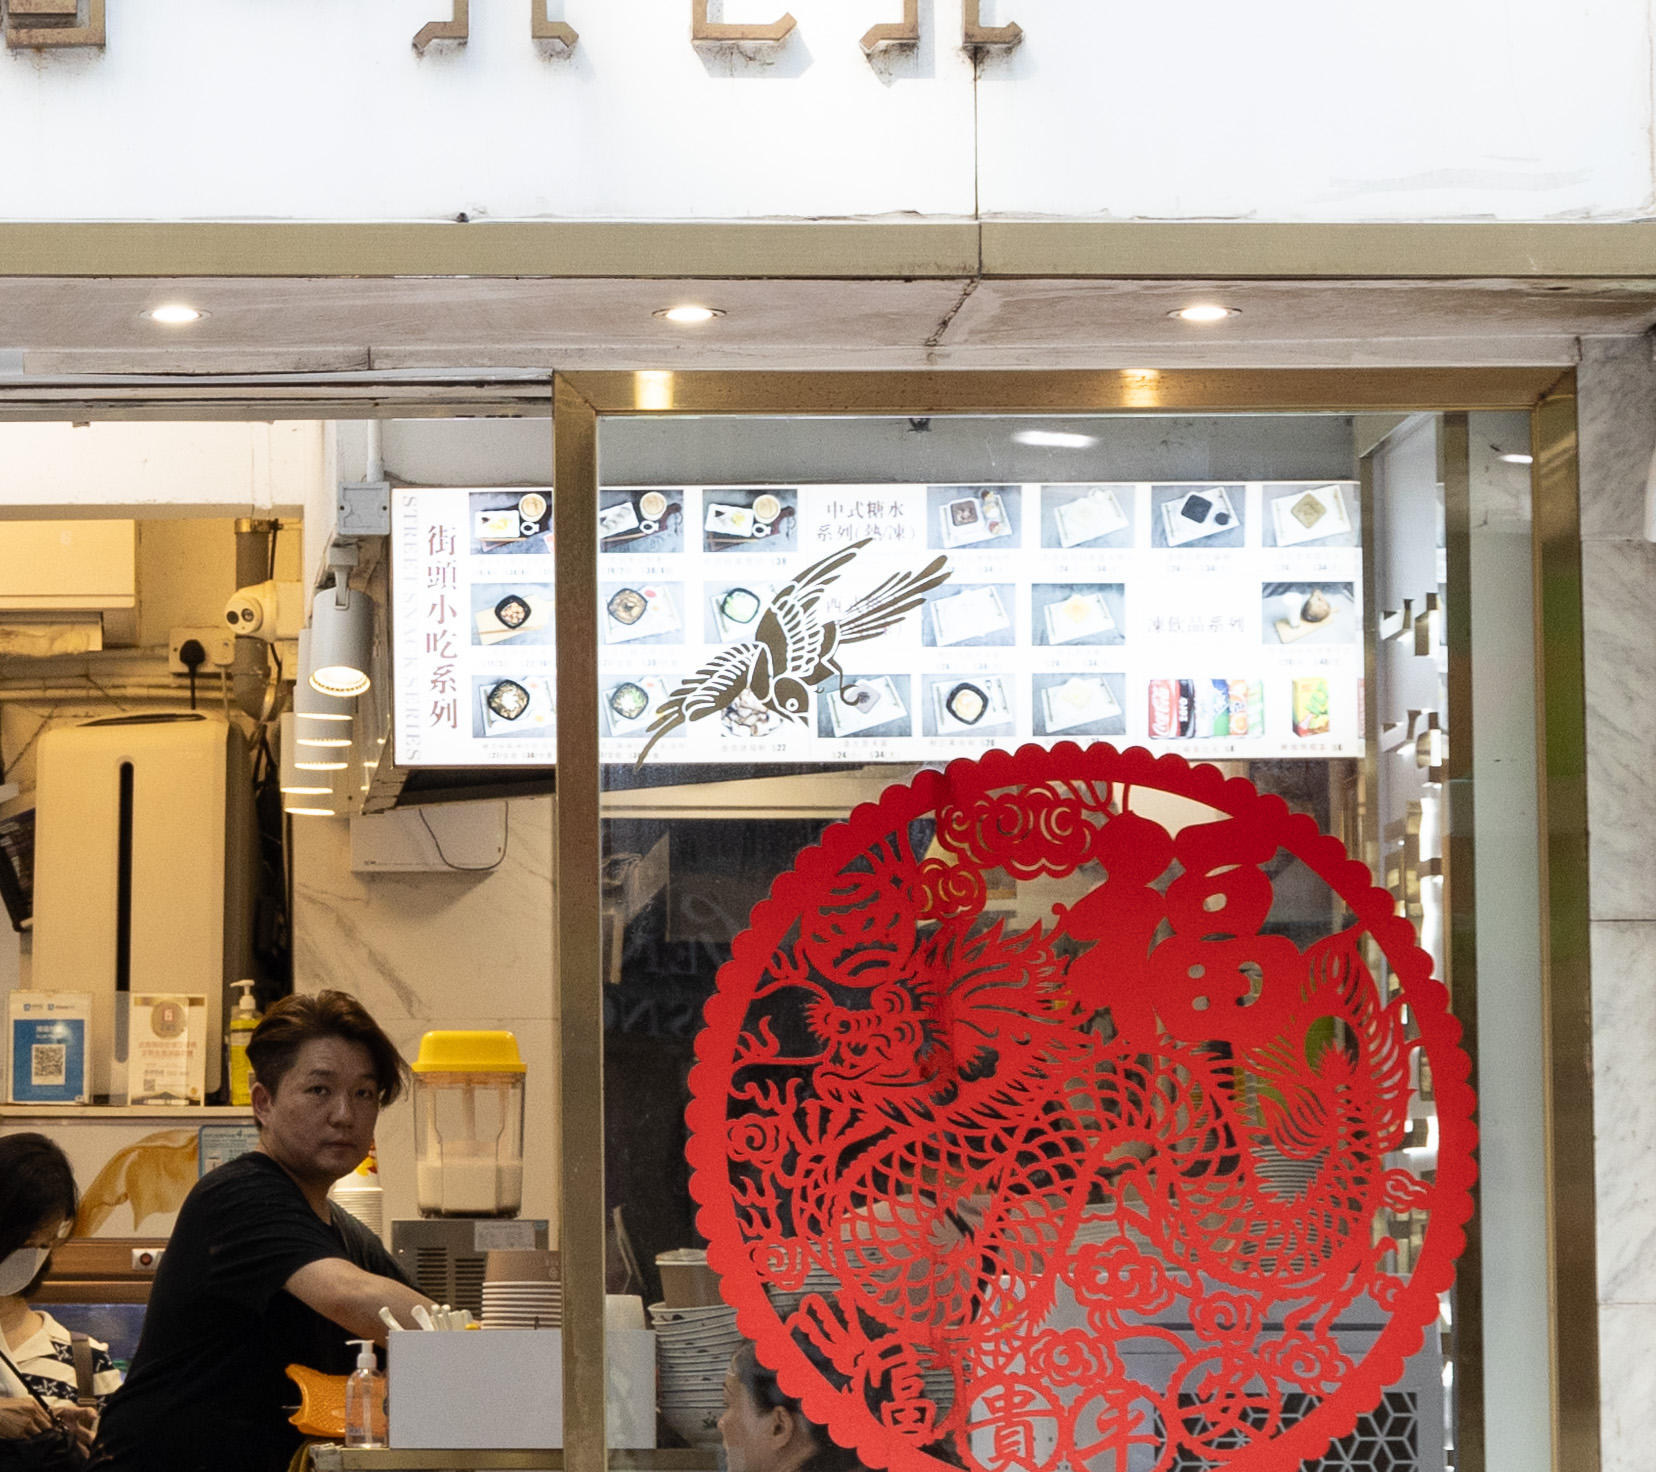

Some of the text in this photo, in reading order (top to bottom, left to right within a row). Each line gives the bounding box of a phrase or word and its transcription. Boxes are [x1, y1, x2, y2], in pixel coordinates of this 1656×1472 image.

[426, 524, 459, 731] 街頭小吃系列
